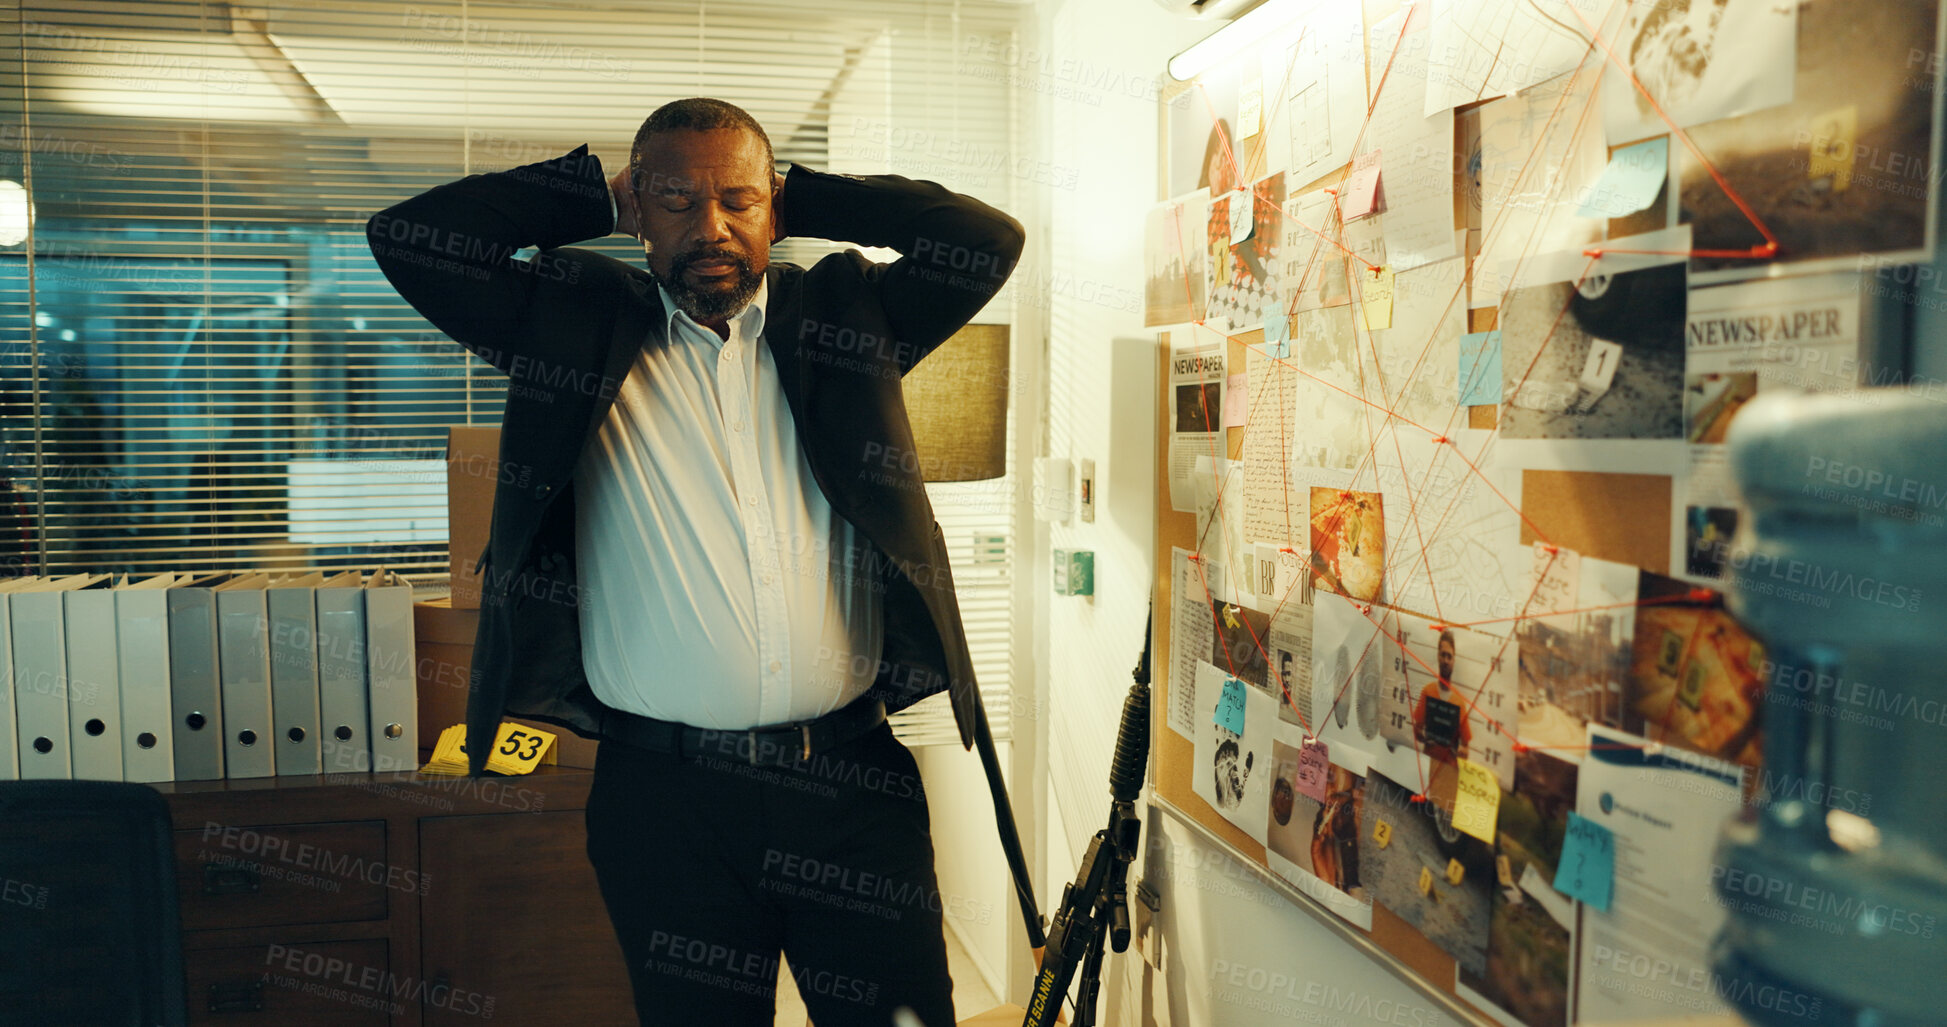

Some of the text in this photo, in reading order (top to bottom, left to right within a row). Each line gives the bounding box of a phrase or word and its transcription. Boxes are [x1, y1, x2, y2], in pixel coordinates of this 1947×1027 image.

[1688, 308, 1841, 347] NEWSPAPER
[1174, 356, 1224, 375] NEWSPAPER
[500, 730, 544, 761] 53
